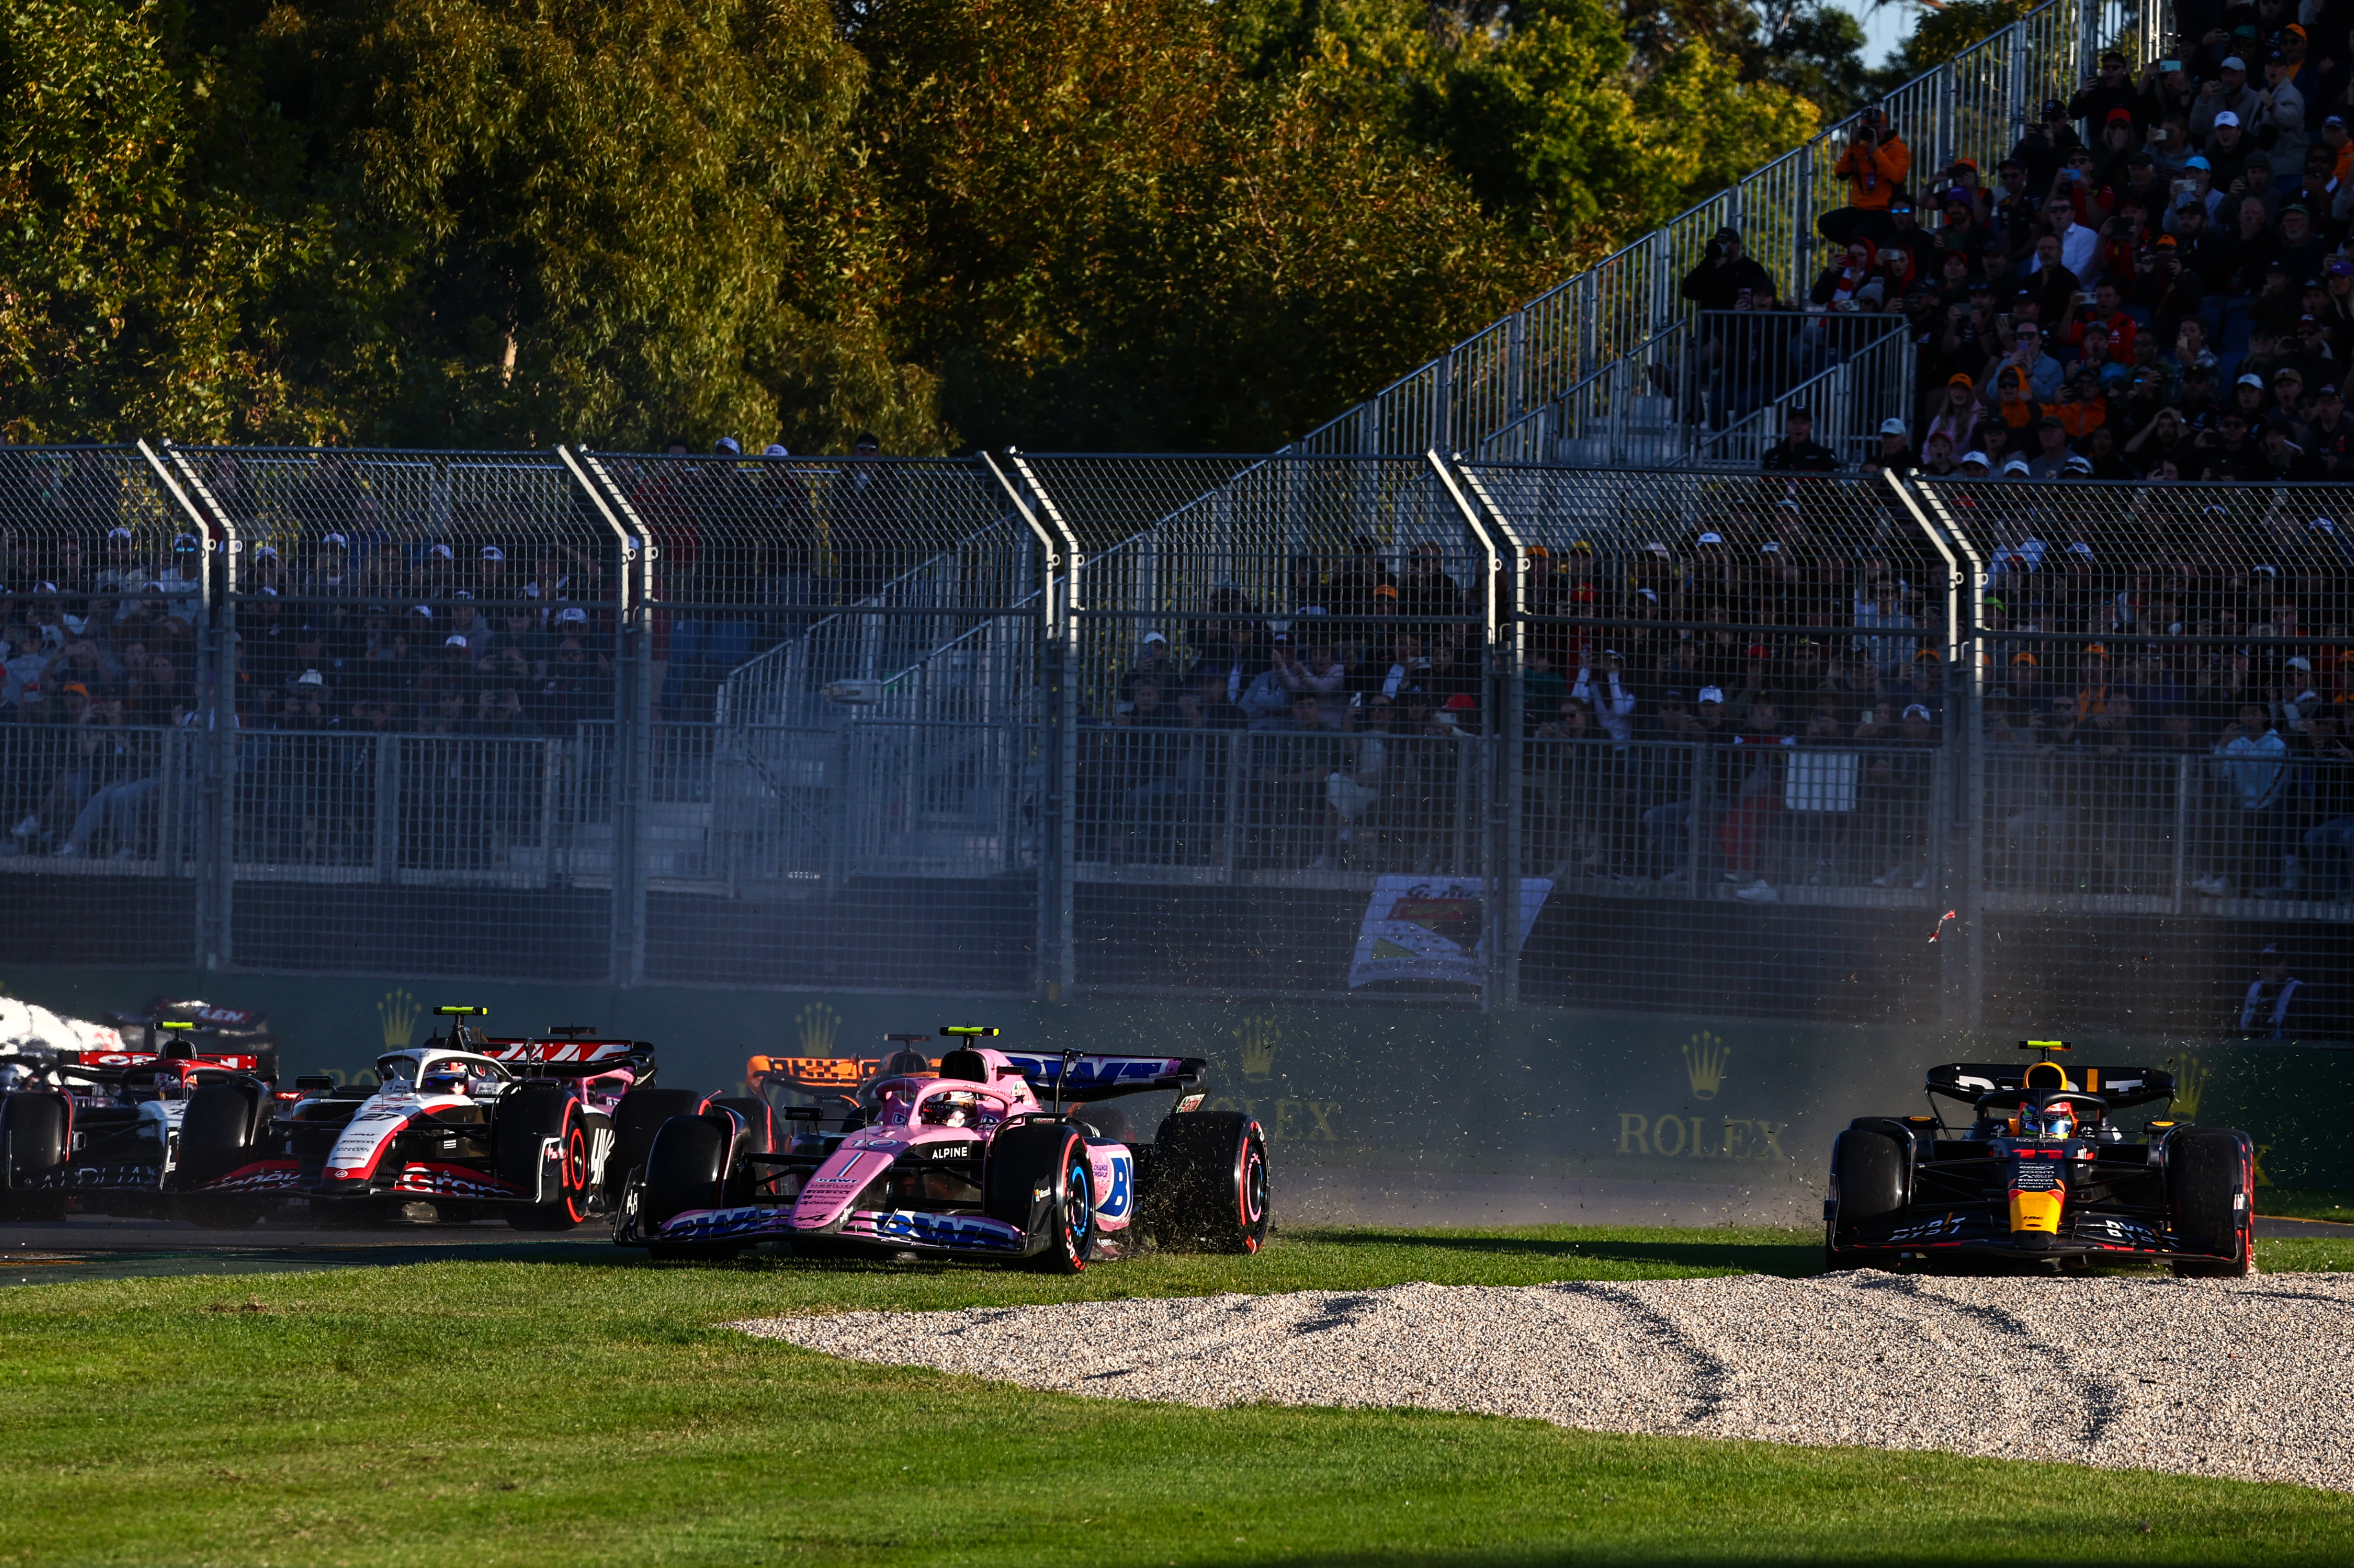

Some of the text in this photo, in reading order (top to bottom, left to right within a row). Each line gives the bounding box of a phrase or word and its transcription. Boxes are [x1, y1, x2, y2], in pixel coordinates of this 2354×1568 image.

[1617, 1113, 1788, 1161] ROLEX
[932, 1147, 967, 1159] ALPINE
[2011, 1149, 2063, 1158] 11
